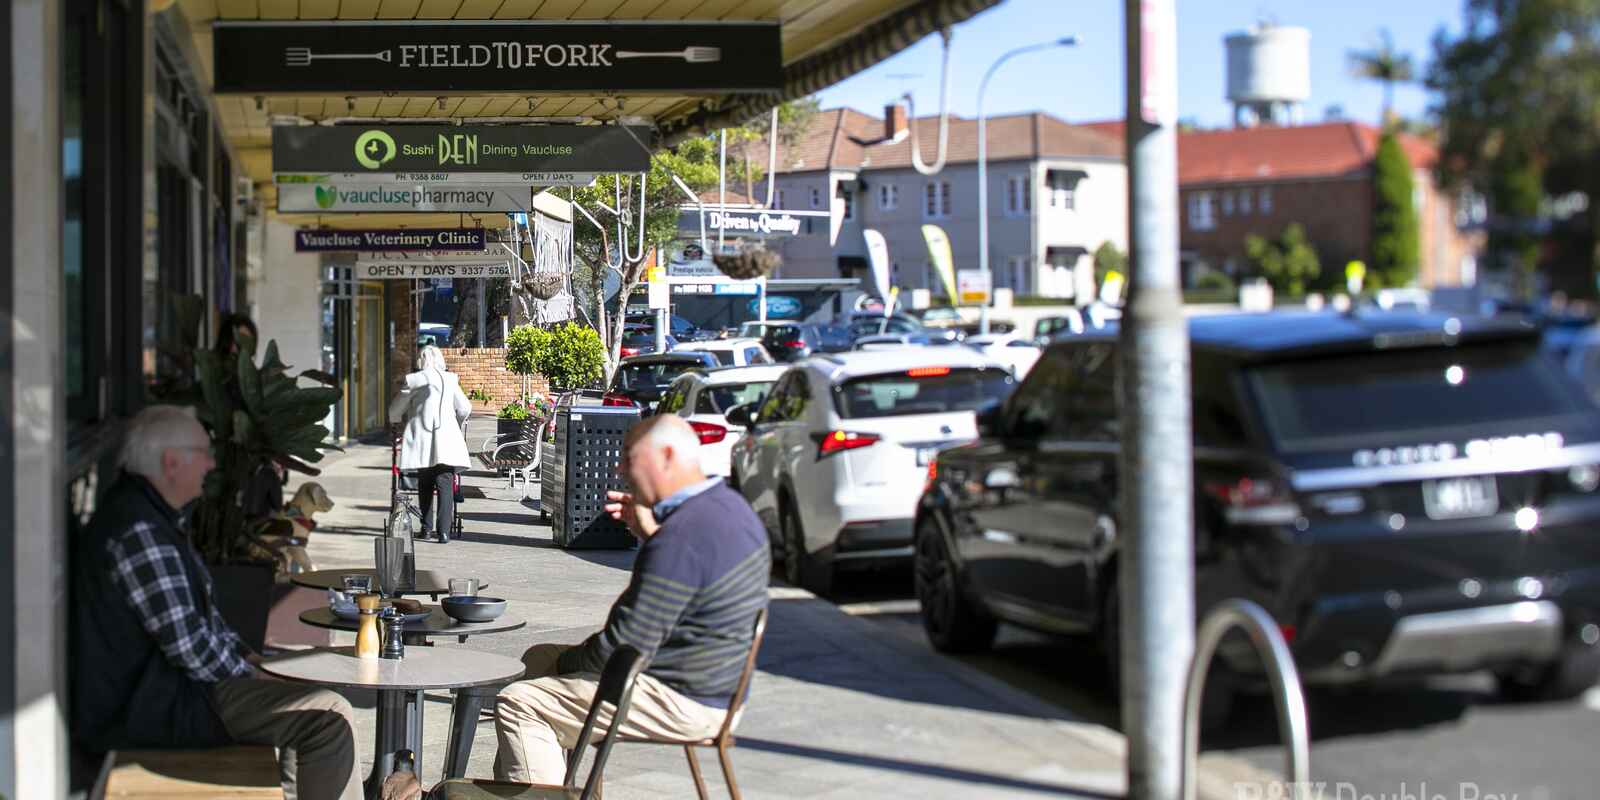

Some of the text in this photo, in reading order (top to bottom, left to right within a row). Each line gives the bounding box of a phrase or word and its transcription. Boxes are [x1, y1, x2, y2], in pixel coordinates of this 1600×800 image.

[402, 134, 573, 165] Sushi DEN Dining Vaucluse
[300, 231, 480, 248] Vaucluse Veterinary Clinic
[368, 265, 405, 276] OPEN
[410, 265, 417, 275] 7
[423, 264, 457, 275] DAYS
[461, 265, 484, 275] 9337
